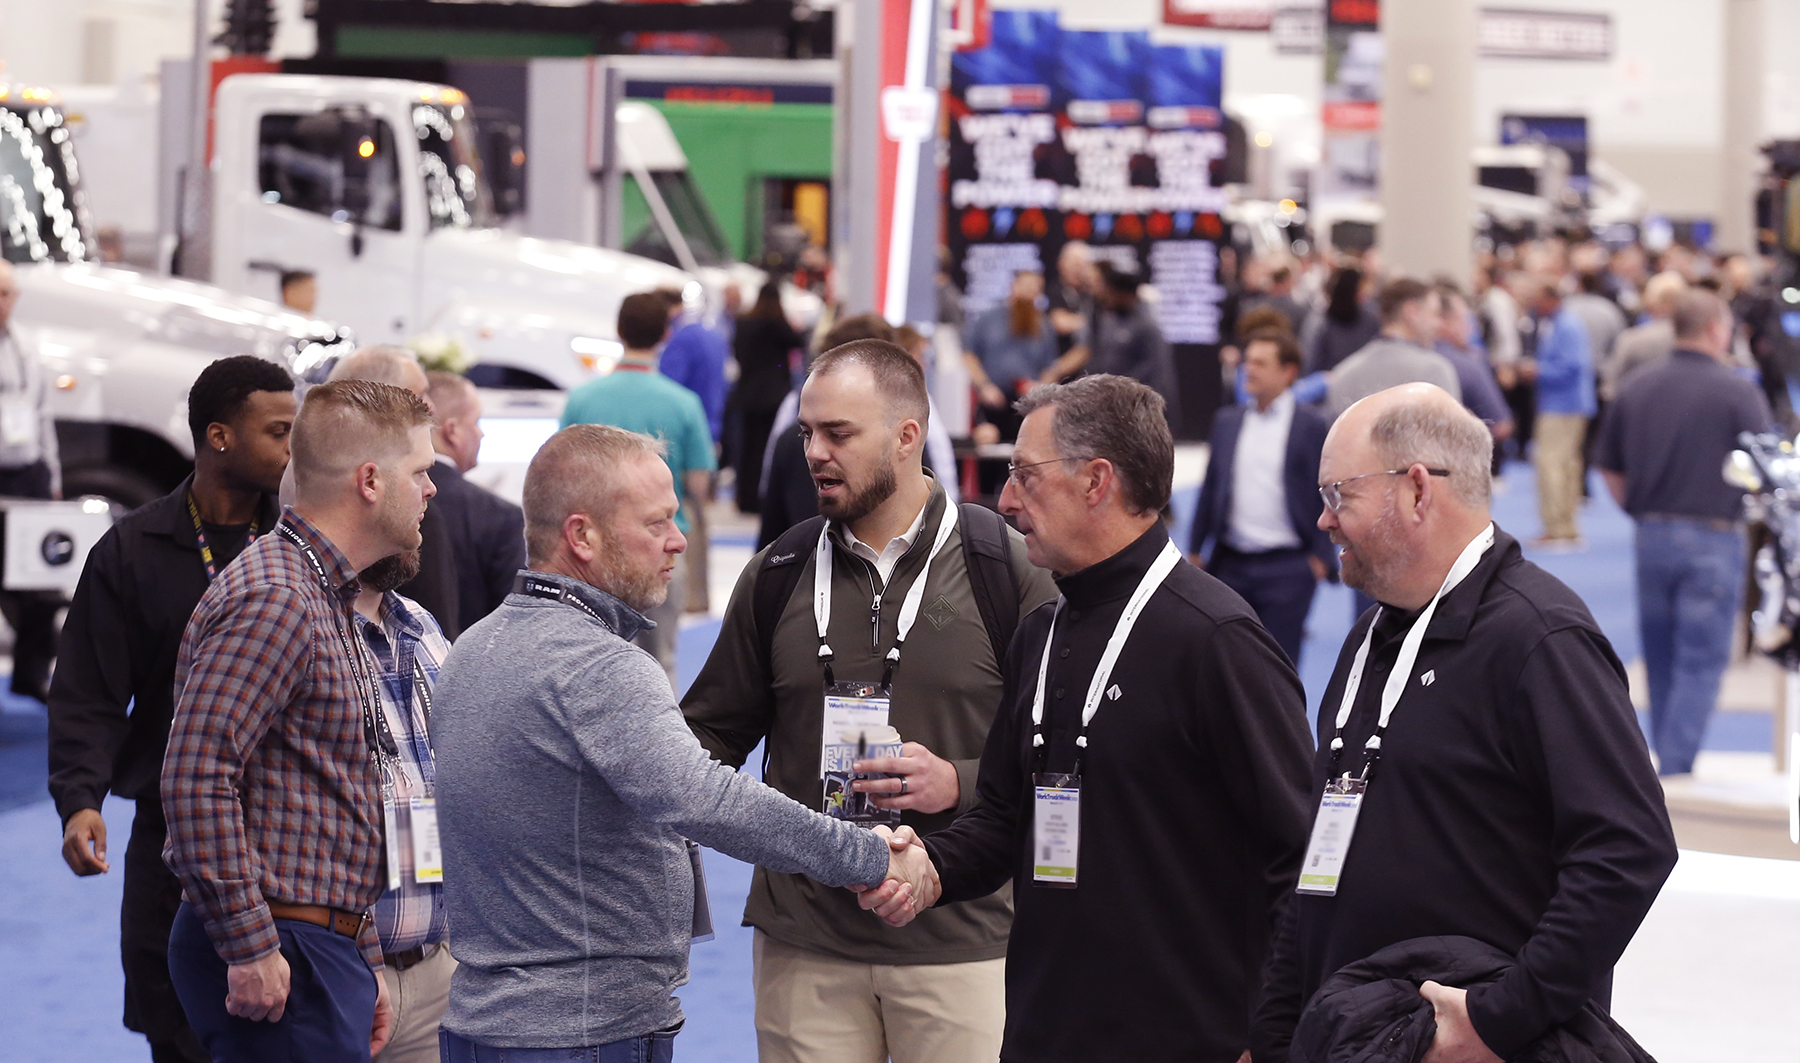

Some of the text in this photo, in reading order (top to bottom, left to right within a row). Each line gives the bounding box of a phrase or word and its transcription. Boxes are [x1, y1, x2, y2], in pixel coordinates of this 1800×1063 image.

[535, 584, 561, 595] RAM
[875, 745, 903, 759] DAY
[825, 758, 839, 772] IS
